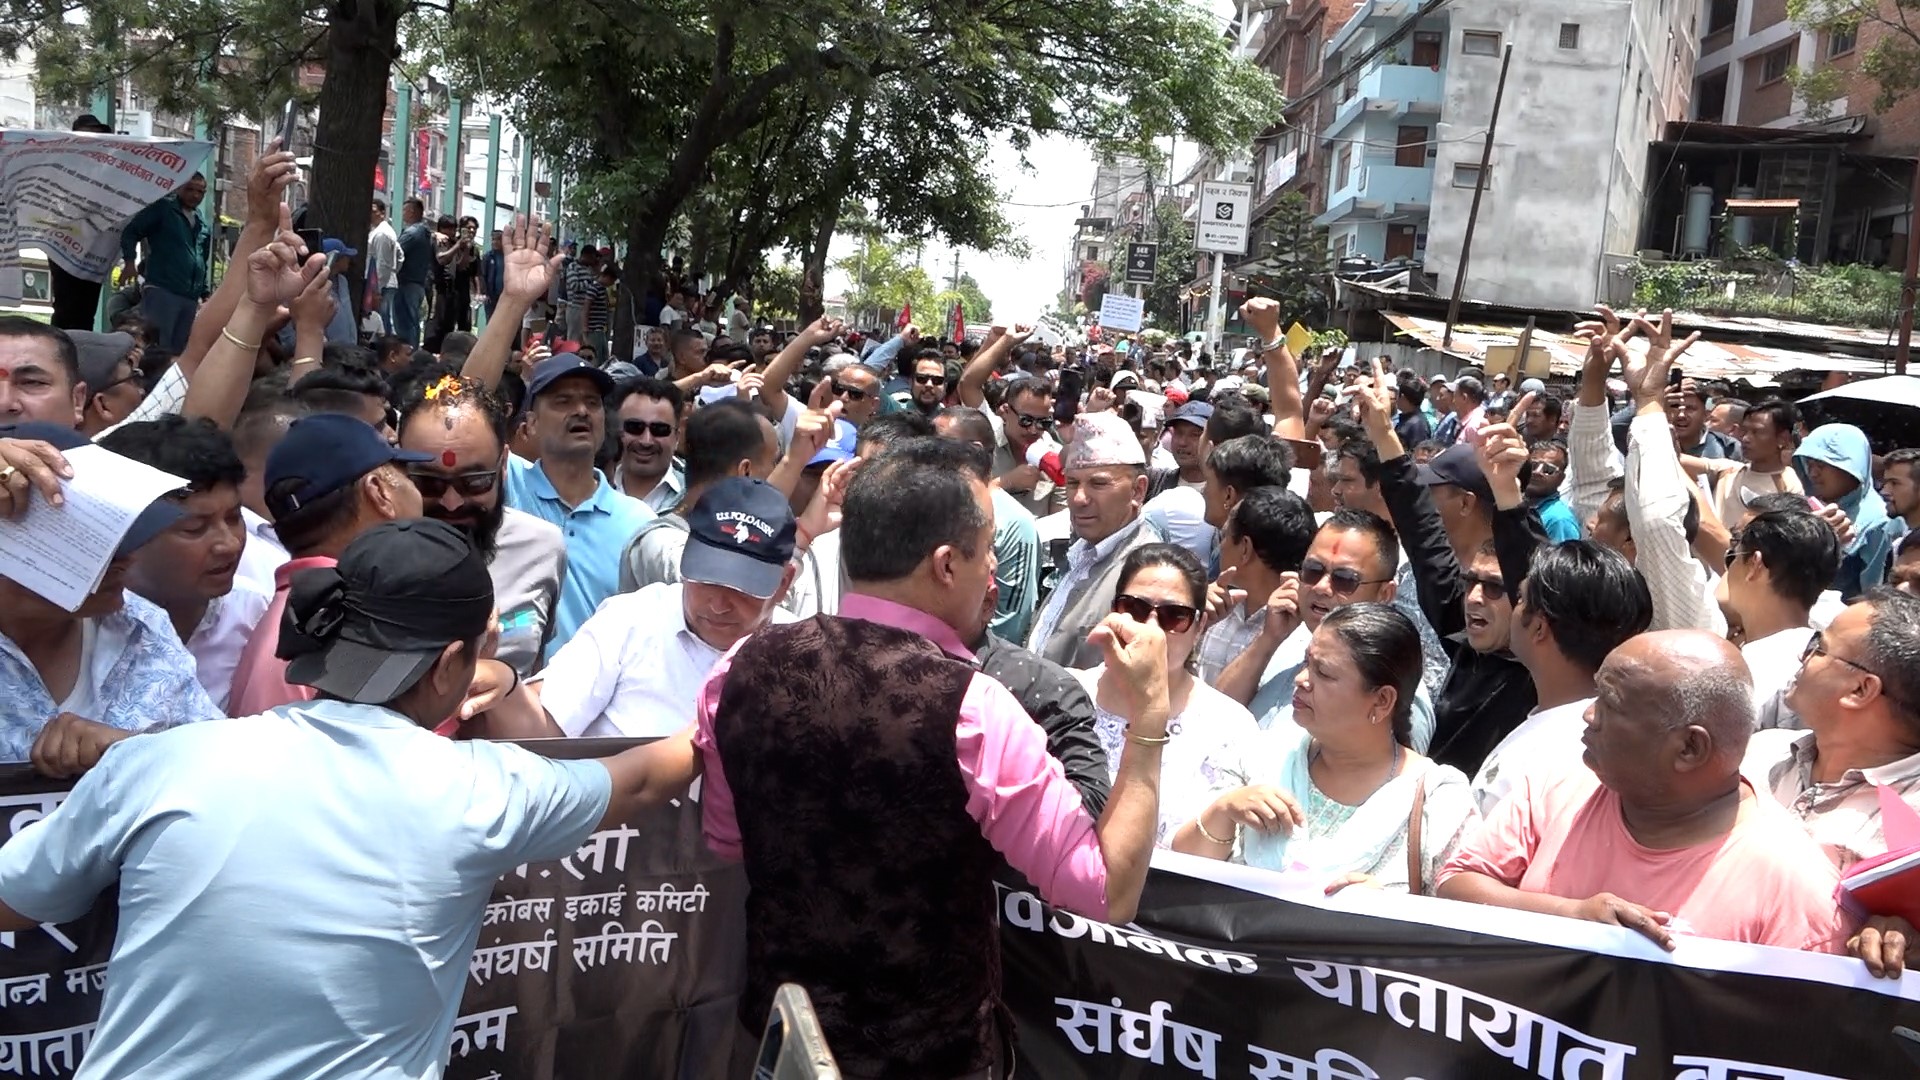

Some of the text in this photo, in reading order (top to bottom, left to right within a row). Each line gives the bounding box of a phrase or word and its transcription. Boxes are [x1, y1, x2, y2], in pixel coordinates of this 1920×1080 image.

[563, 884, 627, 920] इकाई
[636, 882, 710, 913] कमिटी
[470, 919, 678, 986] संघर्ष समिति
